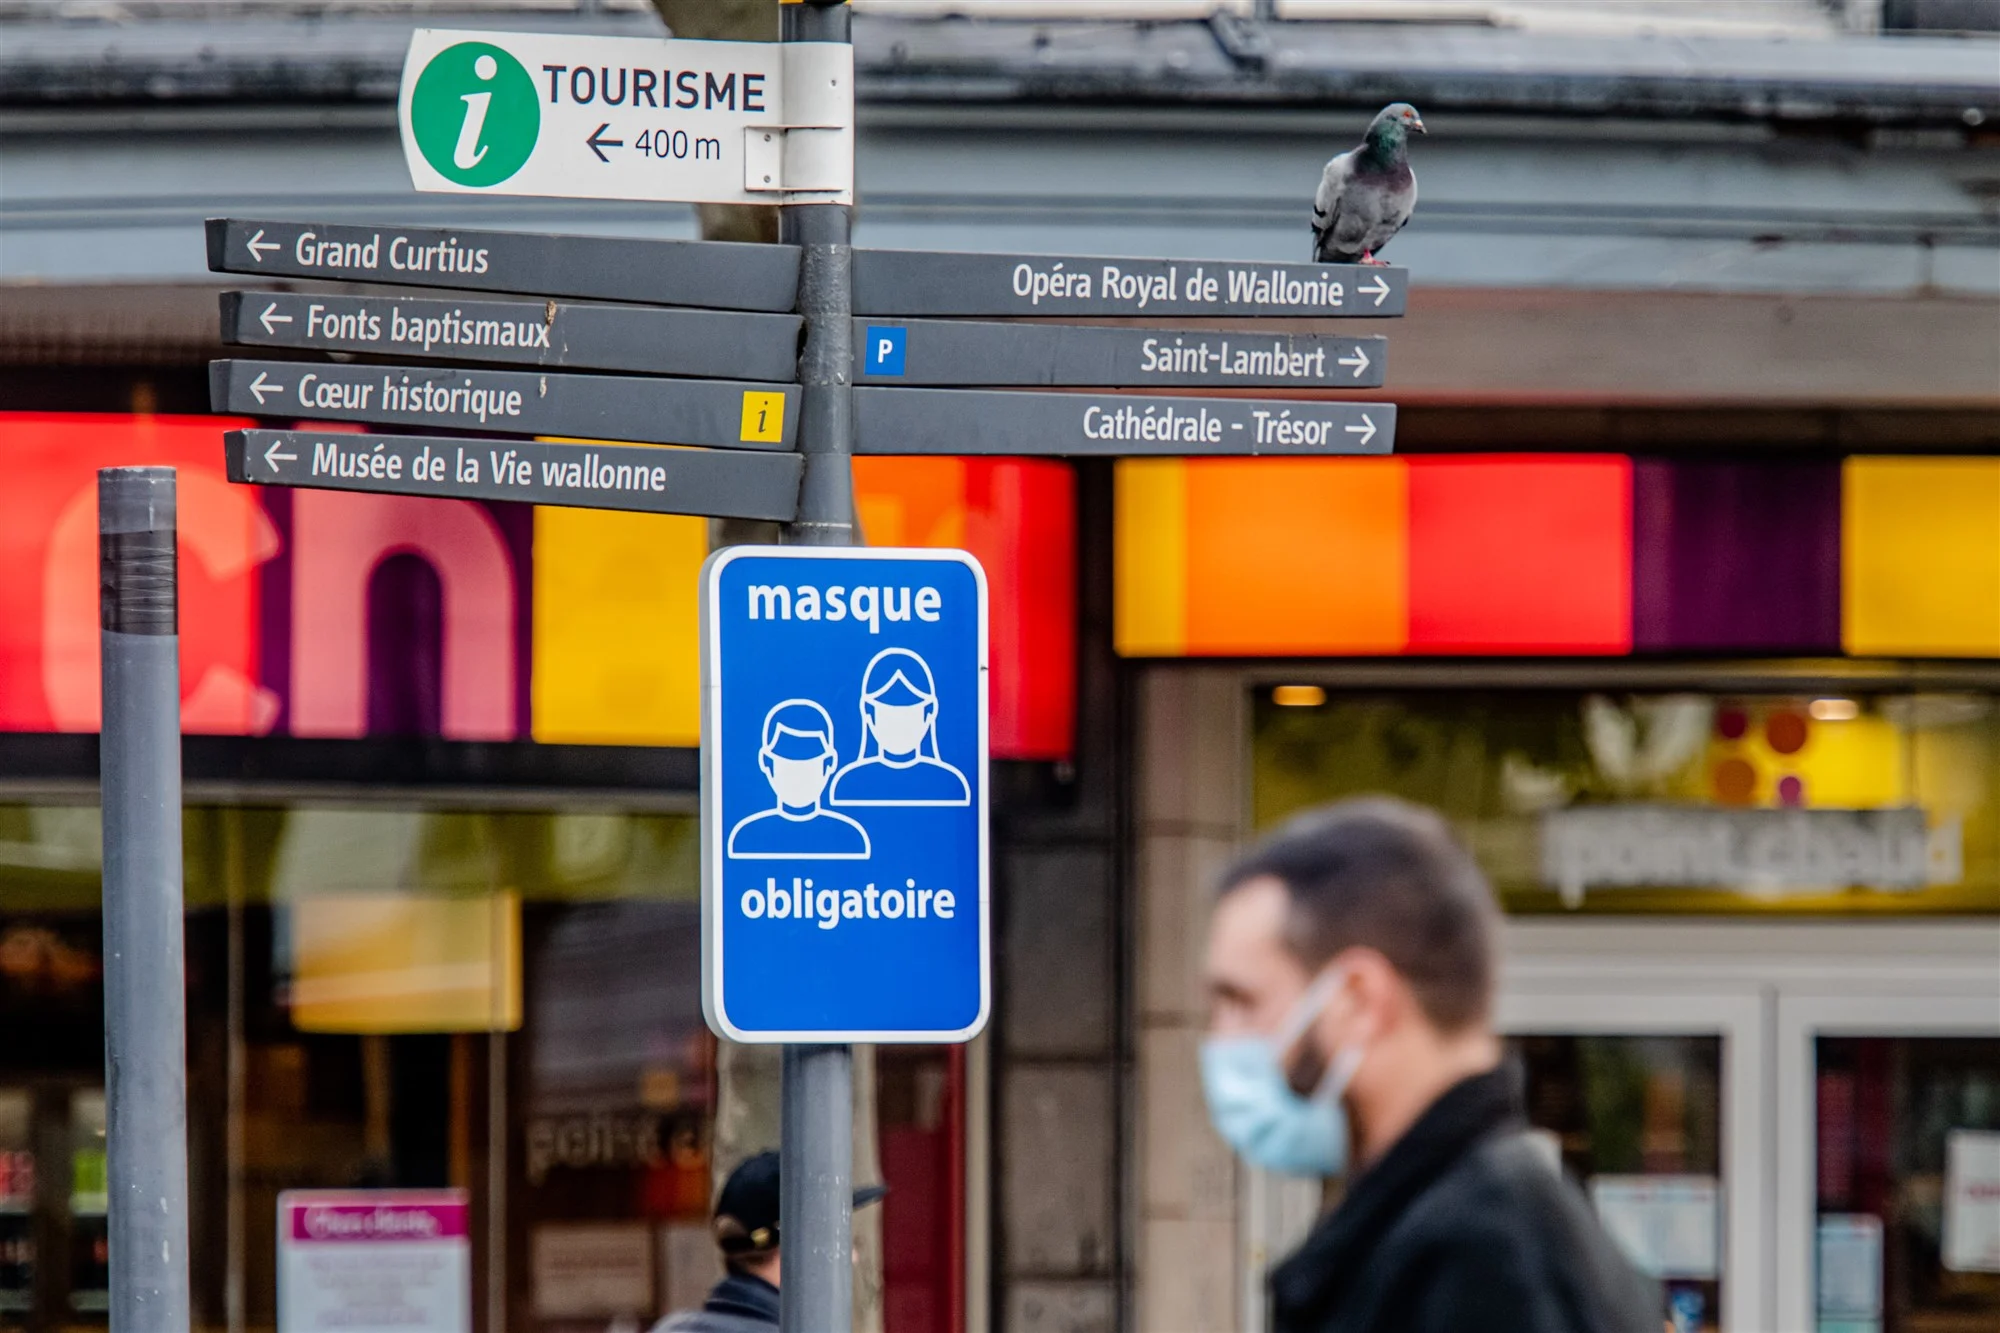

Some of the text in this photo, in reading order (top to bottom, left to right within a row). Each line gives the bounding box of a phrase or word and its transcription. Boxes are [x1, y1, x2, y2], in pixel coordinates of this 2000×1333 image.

[542, 64, 766, 112] TOURISME
[634, 128, 722, 160] 400 m
[295, 232, 490, 275] Grand Curtius
[1012, 261, 1345, 309] Opéra Royal de Wallonie
[307, 304, 549, 352] Fonts baptismaux
[877, 338, 894, 363] P
[1140, 337, 1326, 379] Saint-Lambert
[298, 373, 522, 423] Cœur historique
[755, 401, 770, 433] i
[1083, 404, 1222, 443] Cathédrale
[1252, 409, 1333, 445] Trésor
[311, 442, 667, 492] Musée de la Vie wallonne
[747, 584, 942, 634] masque
[741, 877, 956, 930] obligatoire
